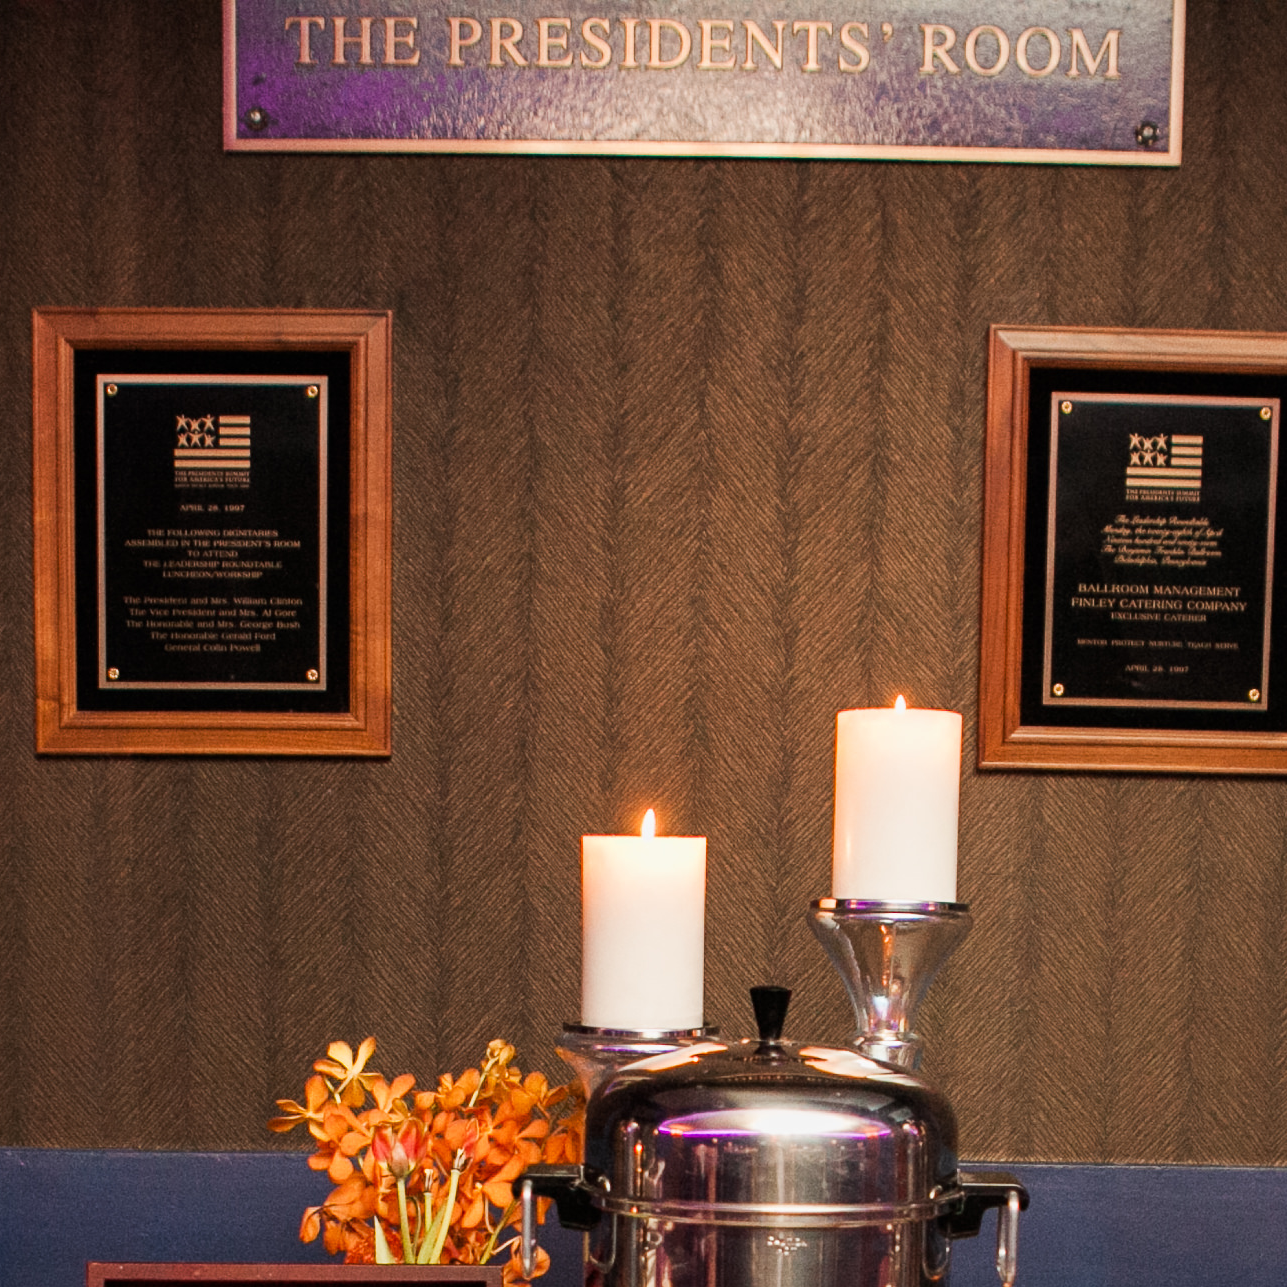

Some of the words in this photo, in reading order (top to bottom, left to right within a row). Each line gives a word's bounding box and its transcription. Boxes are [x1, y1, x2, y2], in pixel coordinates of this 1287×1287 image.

[284, 16, 422, 67] THE
[446, 16, 895, 74] PRESIDENTS'
[918, 22, 1123, 81] ROOM
[179, 504, 203, 512] APRIL
[147, 529, 164, 537] THE
[167, 529, 221, 537] FOLLOWING
[223, 529, 279, 537] DIGNITARIES
[125, 540, 179, 548] ASSEMBLED
[181, 540, 191, 548] IN
[194, 540, 212, 548] THE
[274, 540, 301, 548] ROOM
[187, 550, 200, 558] TO
[202, 550, 238, 558] ATTEND
[143, 560, 161, 568] THE
[163, 560, 219, 568] LEADERSHIP
[221, 560, 283, 568] ROUNDTABLE
[1078, 583, 1149, 594] BALLROOM
[1153, 585, 1241, 598] MANAGEMENT
[1071, 597, 1115, 608] FINLEY
[1119, 598, 1183, 610] CATERING
[1187, 600, 1247, 612] COMPANY
[149, 608, 170, 616] Vice
[172, 608, 216, 616] President
[275, 608, 297, 616] Gore
[1111, 612, 1161, 621] EXCLUSIVE
[1164, 613, 1207, 622] CATERER
[1125, 664, 1149, 672] APRIL
